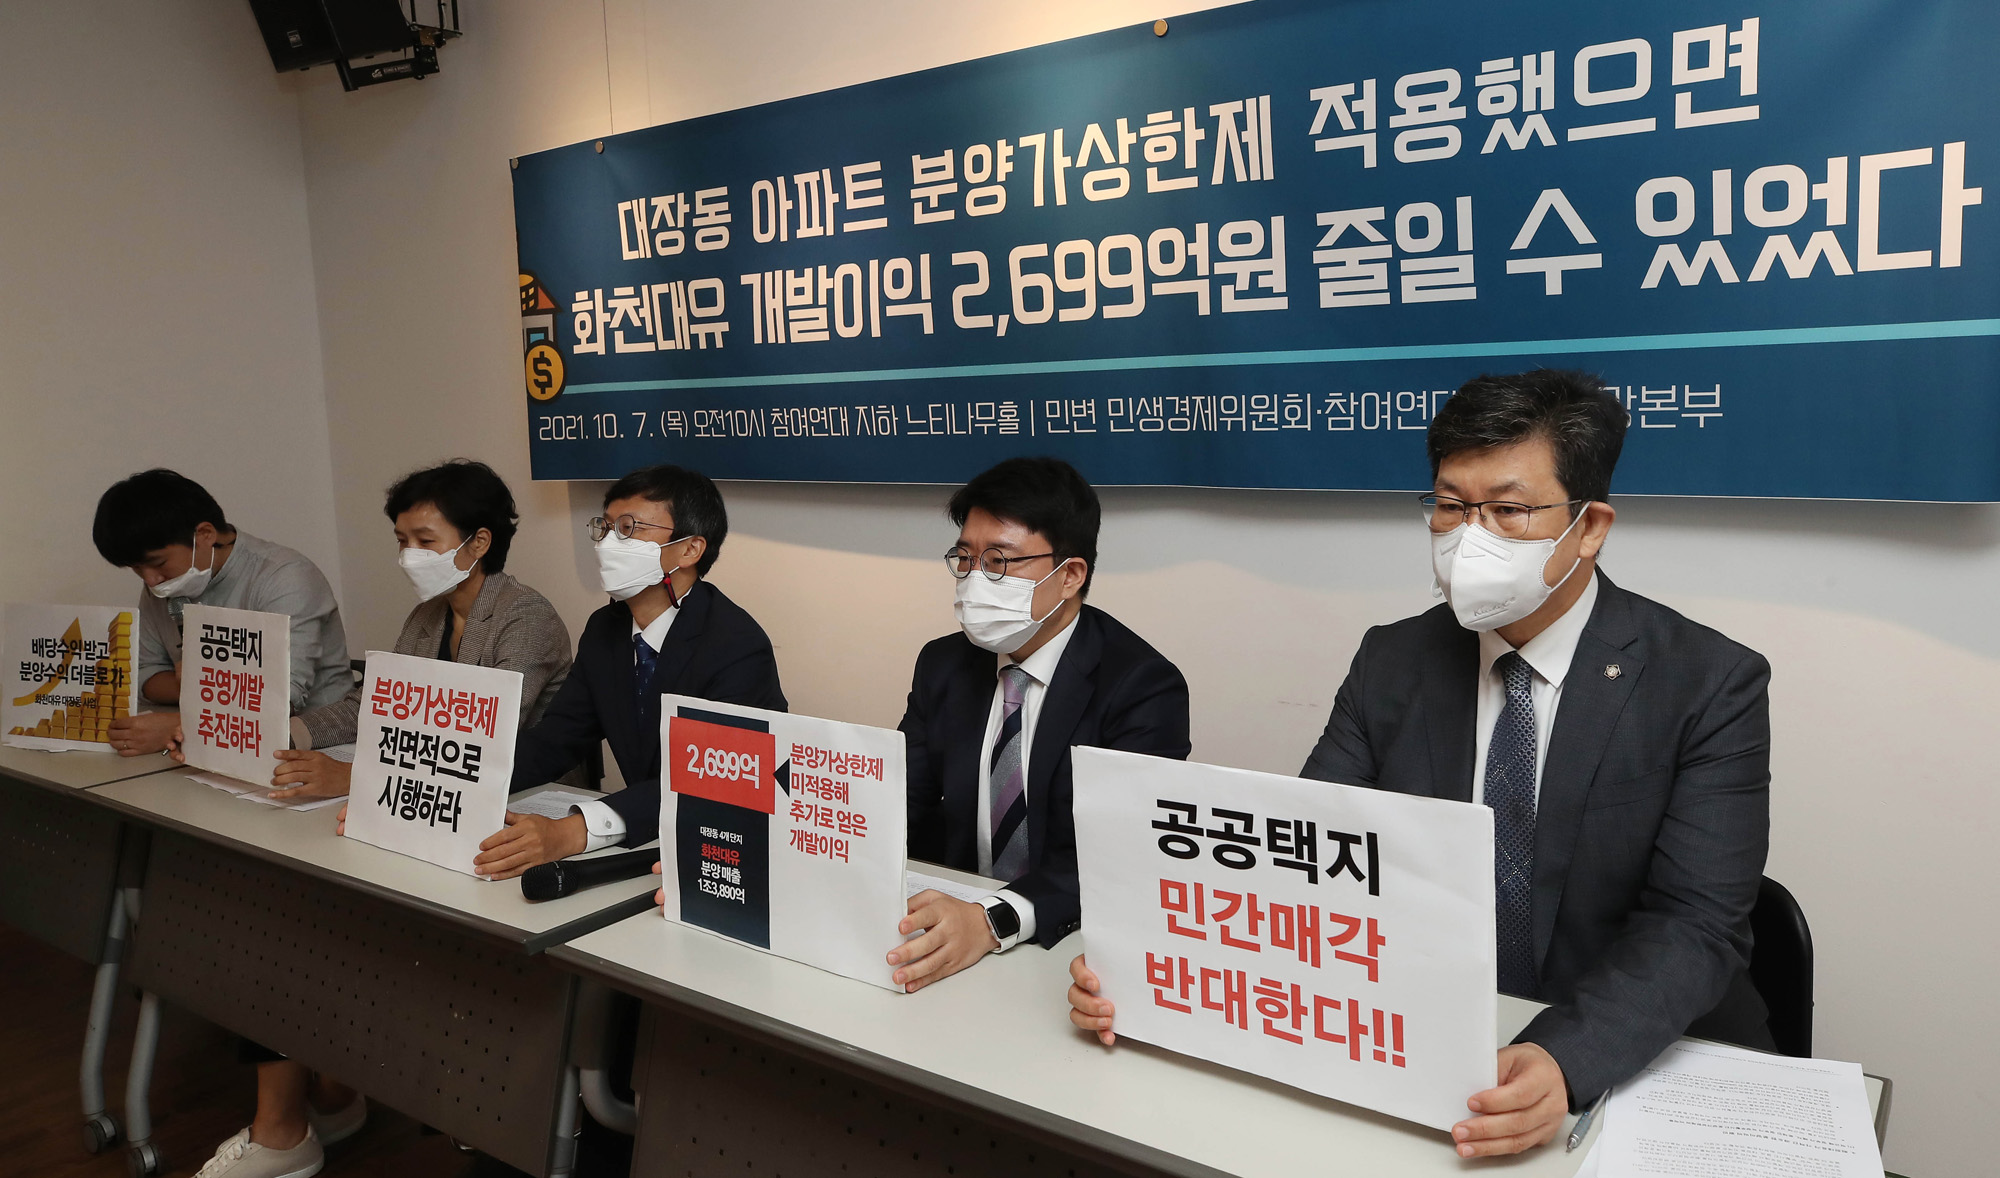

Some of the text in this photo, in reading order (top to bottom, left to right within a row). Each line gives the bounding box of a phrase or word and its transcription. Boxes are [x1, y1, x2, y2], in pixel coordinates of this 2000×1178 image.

[617, 17, 1760, 260] 대장동 아파트 분양가상한제 적용했으면
[572, 141, 1983, 355] 화천대유 개발이익 2,699억원 줄일 수 있었다
[539, 415, 589, 440] 2021.
[593, 413, 624, 439] 10.
[632, 412, 654, 438] 7.
[660, 410, 688, 438] (목)
[694, 408, 766, 438] 오전10시
[771, 406, 849, 437] 참여연대
[855, 405, 898, 436] 지하
[906, 401, 1020, 435] 느티나무홀
[1045, 398, 1097, 434] 민변
[32, 638, 109, 661] 배당수익 받고
[200, 624, 263, 668] 공공택지
[19, 661, 69, 684] 분양수익
[199, 667, 264, 712] 공영개발
[35, 694, 61, 706] 화천대유
[371, 676, 499, 739] 분양가상한제
[198, 708, 261, 757] 추진하라
[378, 726, 482, 783] 전면적으로
[686, 744, 760, 790] 2,699억
[790, 743, 883, 781] 분양가상한제
[377, 776, 462, 833] 시행하라
[791, 772, 849, 805] 미적용해
[700, 826, 742, 845] 대장동 4개 단지
[790, 800, 867, 838] 추가로 얻은
[701, 843, 740, 866] 화천대유
[790, 829, 849, 863] 개발이익
[1151, 798, 1380, 897] 공공택지
[698, 878, 745, 904] 1조3,890억
[701, 860, 741, 885] 분양 매출
[1159, 878, 1386, 983] 민간매각
[1145, 951, 1406, 1069] 반대한다!!
